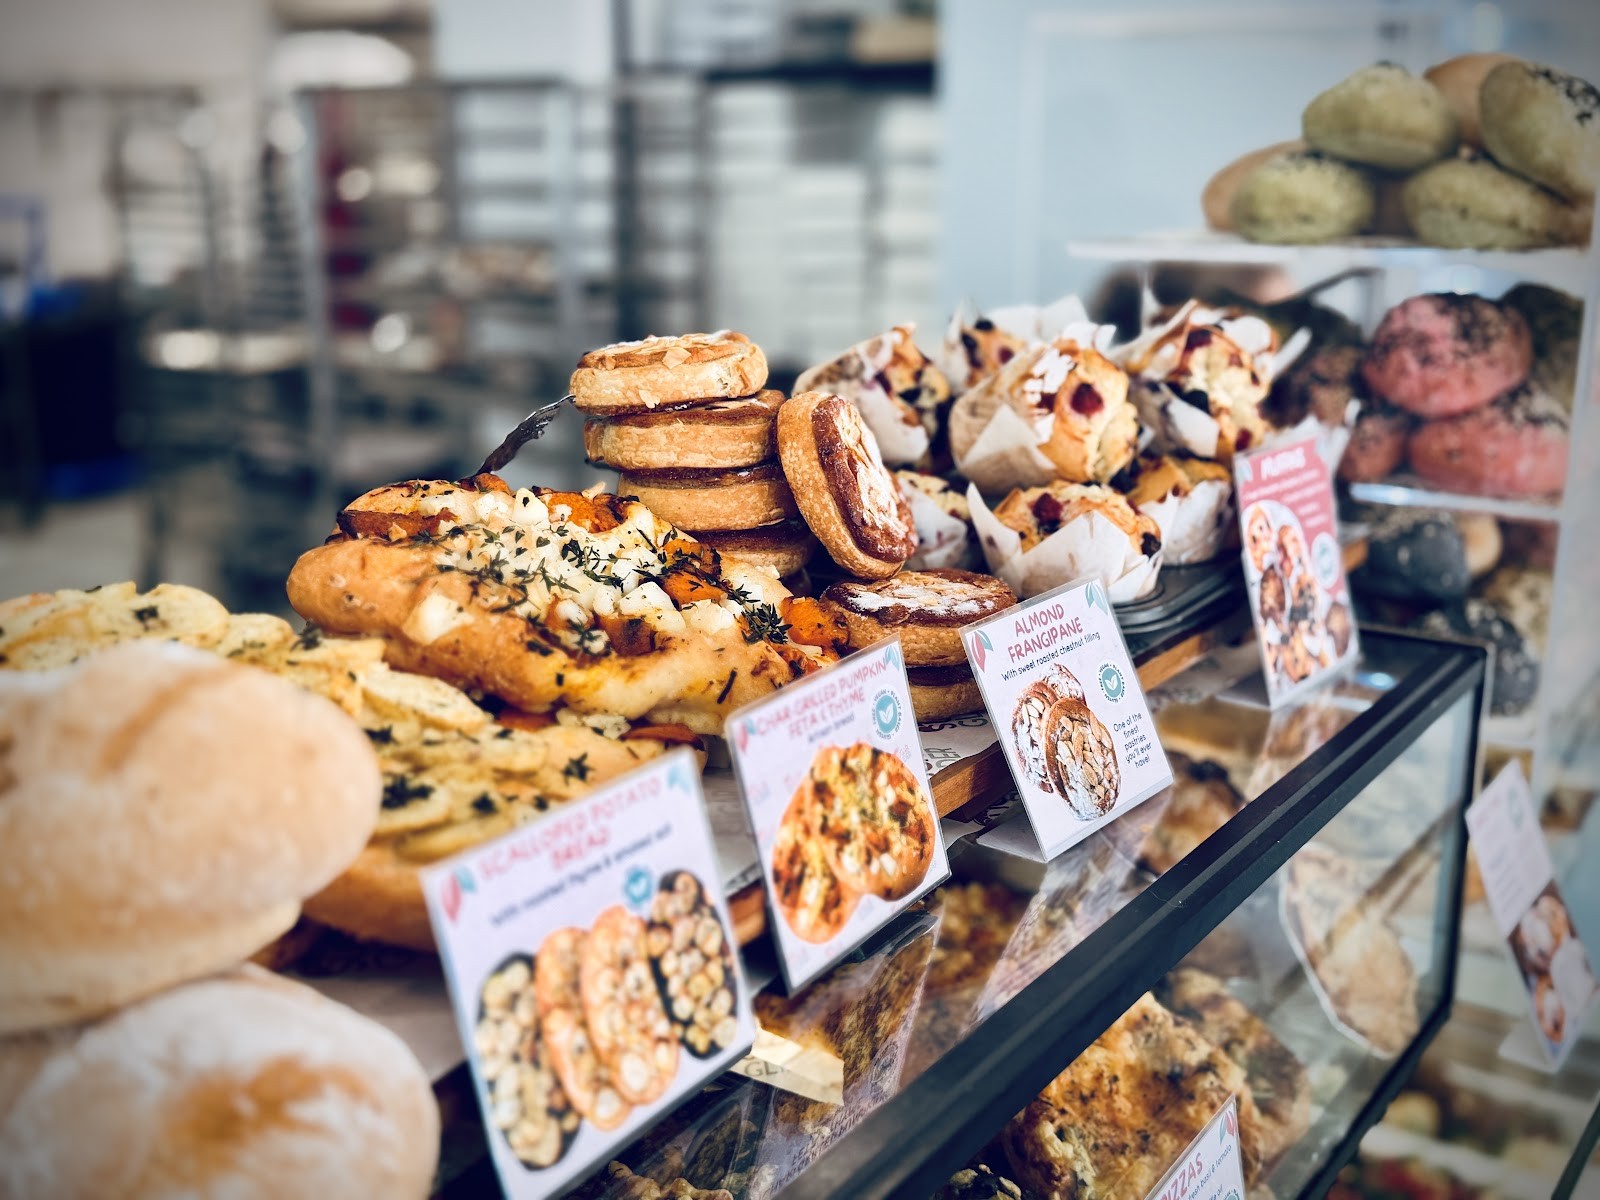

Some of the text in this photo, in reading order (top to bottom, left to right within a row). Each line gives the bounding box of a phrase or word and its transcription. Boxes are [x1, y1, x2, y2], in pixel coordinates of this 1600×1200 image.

[1015, 603, 1064, 637] ALMOND
[1007, 617, 1083, 663] FRANGIPANE
[1001, 632, 1101, 681] With sweet roasted chestnut filling
[838, 657, 887, 689] PUMPKIN
[829, 686, 865, 718] THYME
[890, 690, 902, 710] PLANT
[1113, 712, 1142, 732] One of the
[1123, 725, 1140, 739] finest
[1124, 734, 1147, 752] pastries
[1125, 742, 1152, 764] you'll ever
[1134, 755, 1150, 768] have!
[591, 776, 662, 821] POTATO
[1216, 1144, 1232, 1168] tomato
[1160, 1152, 1203, 1200] IZZAS
